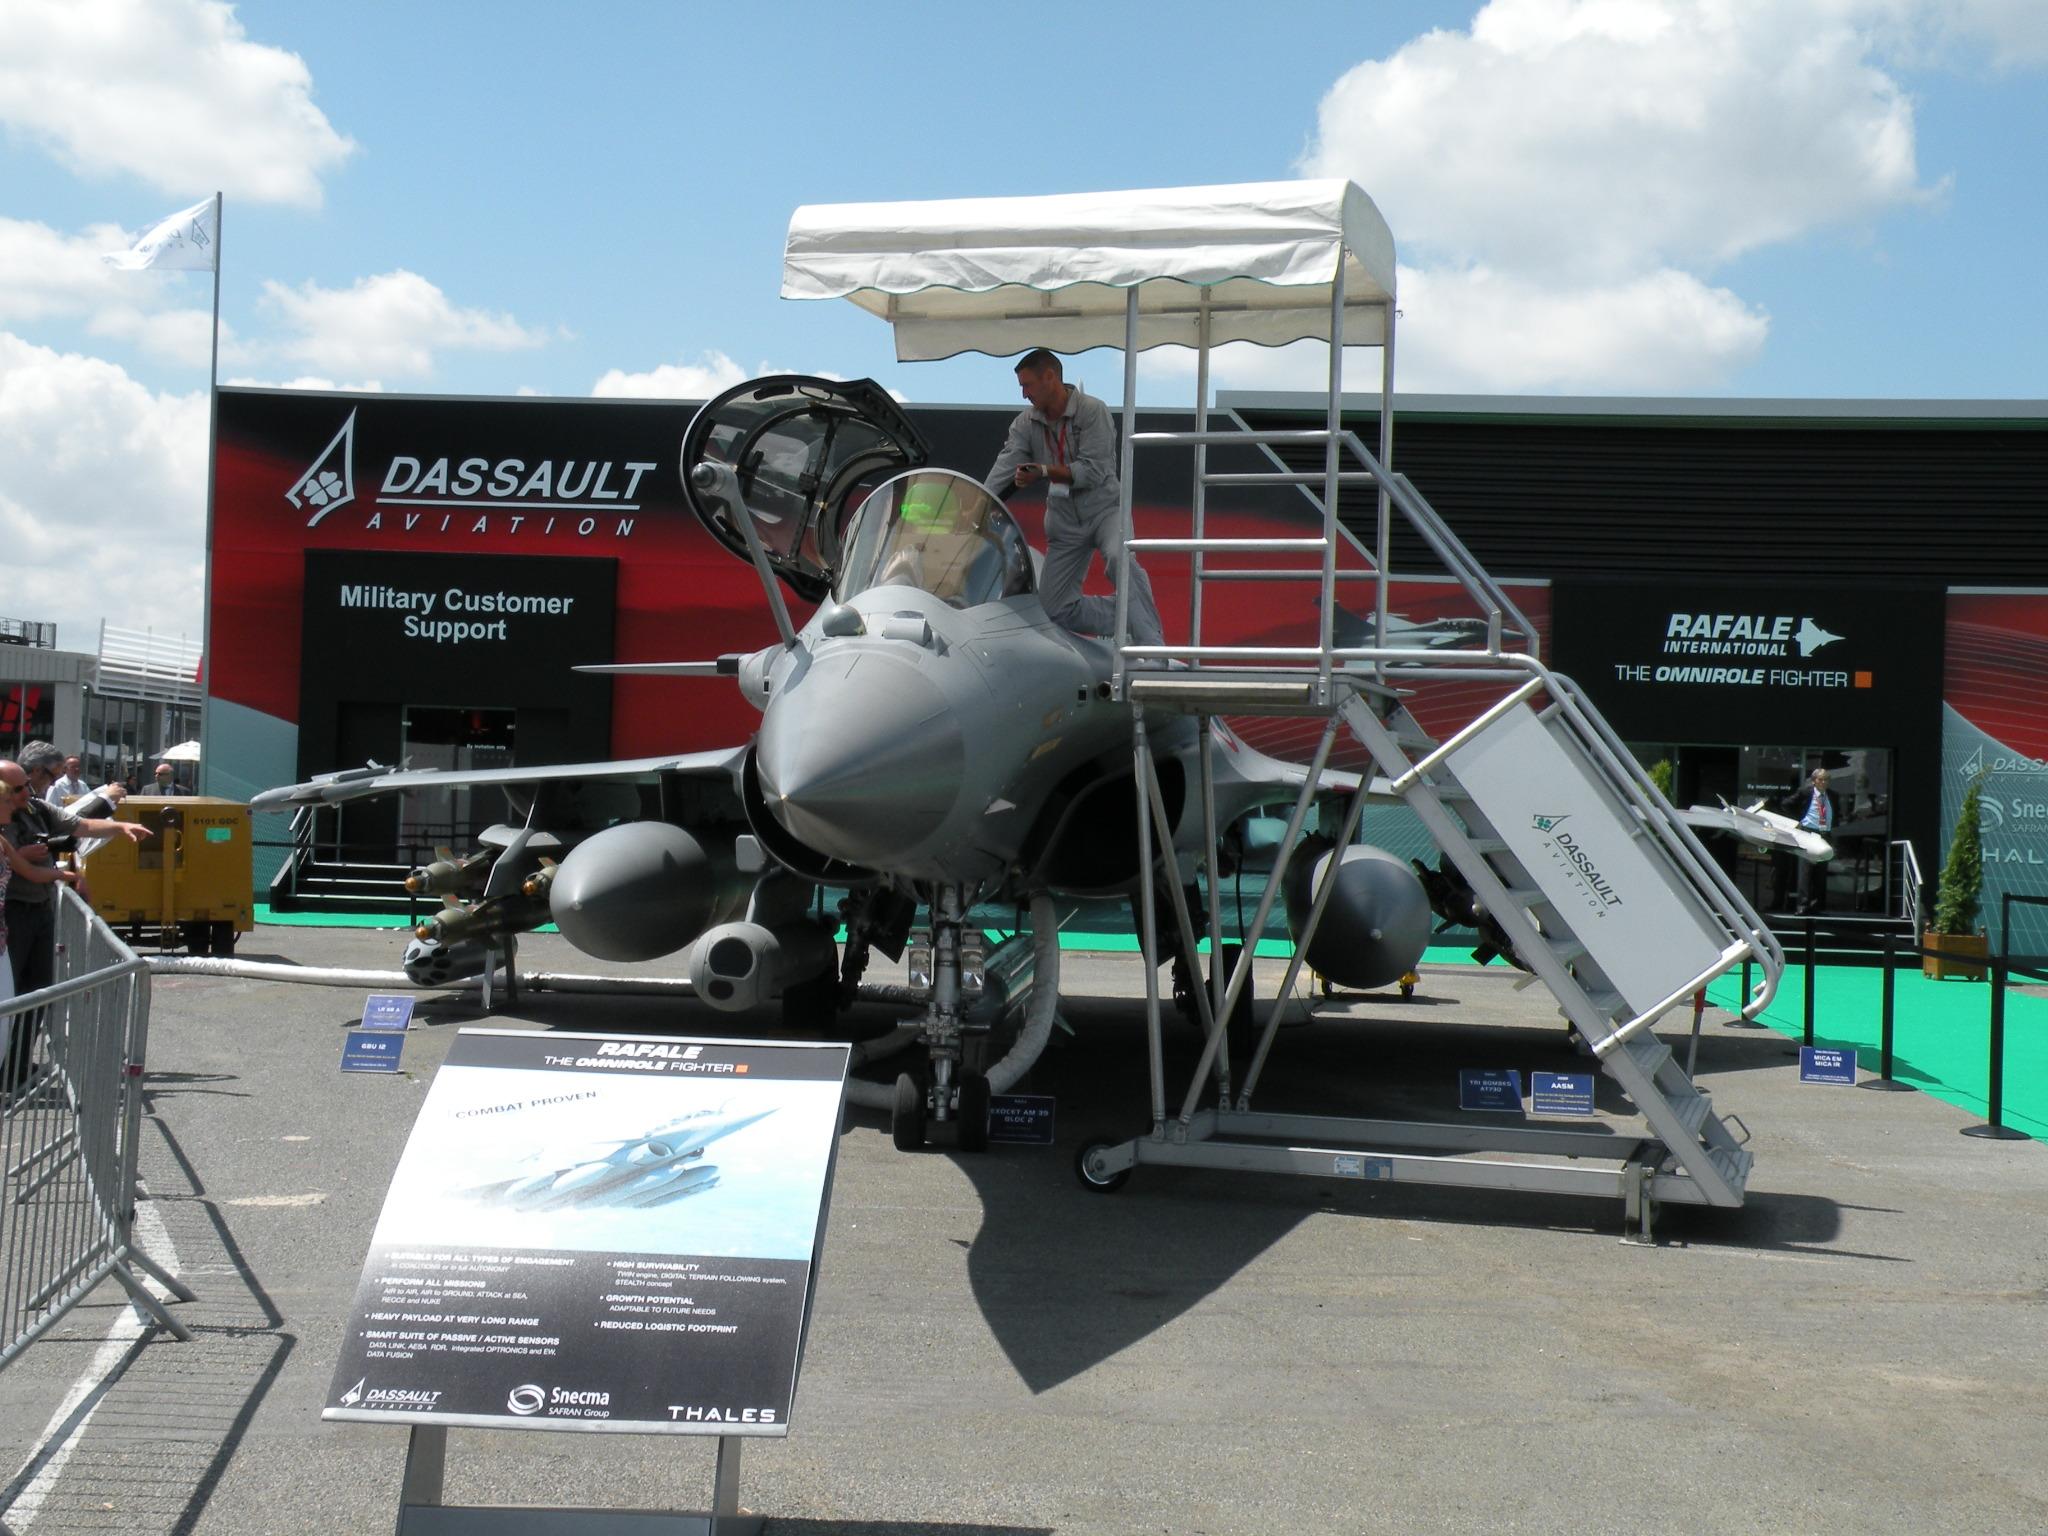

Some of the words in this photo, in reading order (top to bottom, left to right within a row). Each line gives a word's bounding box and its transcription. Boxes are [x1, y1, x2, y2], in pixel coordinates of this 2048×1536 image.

[381, 456, 657, 500] DASSAULT
[367, 512, 634, 536] AVIATION
[340, 585, 436, 615] Military
[445, 588, 573, 615] Customer
[404, 616, 506, 643] Support
[1667, 614, 1794, 641] RAFALE
[1663, 641, 1788, 657] INTERNATIONAL
[1614, 665, 1651, 682] THE
[1655, 666, 1764, 686] OMNIROLE
[1770, 670, 1848, 688] FIGHTER
[2012, 799, 2048, 818] Sne
[1982, 848, 2044, 863] HAL
[1556, 833, 1623, 907] DASSAULT
[1543, 841, 1606, 918] AVIATION
[597, 1042, 703, 1059] RAFALE
[545, 1055, 576, 1067] THE
[576, 1057, 667, 1071] OMNIROLE
[670, 1061, 735, 1073] FIGHTER
[1551, 1082, 1574, 1090] AASM
[455, 1101, 524, 1119] COMBAT
[531, 1091, 597, 1107] PROVEN
[453, 1254, 469, 1262] ALL
[472, 1255, 499, 1263] TYPES
[501, 1256, 512, 1264] OF
[514, 1257, 575, 1266] ENGAGEMENT
[613, 1261, 634, 1269] HIGH
[636, 1262, 699, 1271] SURVIVABILITY
[381, 1278, 423, 1286] PERFORM
[425, 1279, 441, 1287] ALL
[443, 1280, 486, 1288] MISSIONS
[421, 1297, 441, 1305] NUKE
[606, 1295, 645, 1303] GROWTH
[646, 1296, 694, 1305] POTENTIAL
[609, 1305, 650, 1313] ADAPTABLE
[371, 1312, 400, 1321] HEAVY
[401, 1314, 442, 1322] PAYLOAD
[457, 1315, 480, 1324] VERY
[481, 1316, 506, 1325] LONG
[508, 1317, 539, 1326] RANGE
[600, 1321, 643, 1330] REDUCED
[645, 1322, 685, 1331] LOGISTIC
[688, 1324, 738, 1333] FOOTPRINT
[366, 1331, 398, 1339] SMART
[399, 1332, 425, 1340] SUITE
[427, 1333, 439, 1341] OF
[440, 1333, 477, 1342] PASSIVE
[484, 1335, 516, 1343] ACTIVE
[517, 1336, 560, 1345] SENSORS
[369, 1341, 387, 1349] DATA
[485, 1346, 528, 1354] OPTRONICS
[529, 1347, 542, 1355] and
[386, 1351, 413, 1359] FUSION
[366, 1389, 442, 1402] DASSAULT
[551, 1387, 610, 1406] Snecma
[361, 1402, 434, 1411] AVIATION
[548, 1407, 582, 1416] SAFRAN
[584, 1408, 610, 1418] Group
[668, 1405, 776, 1423] THALES
